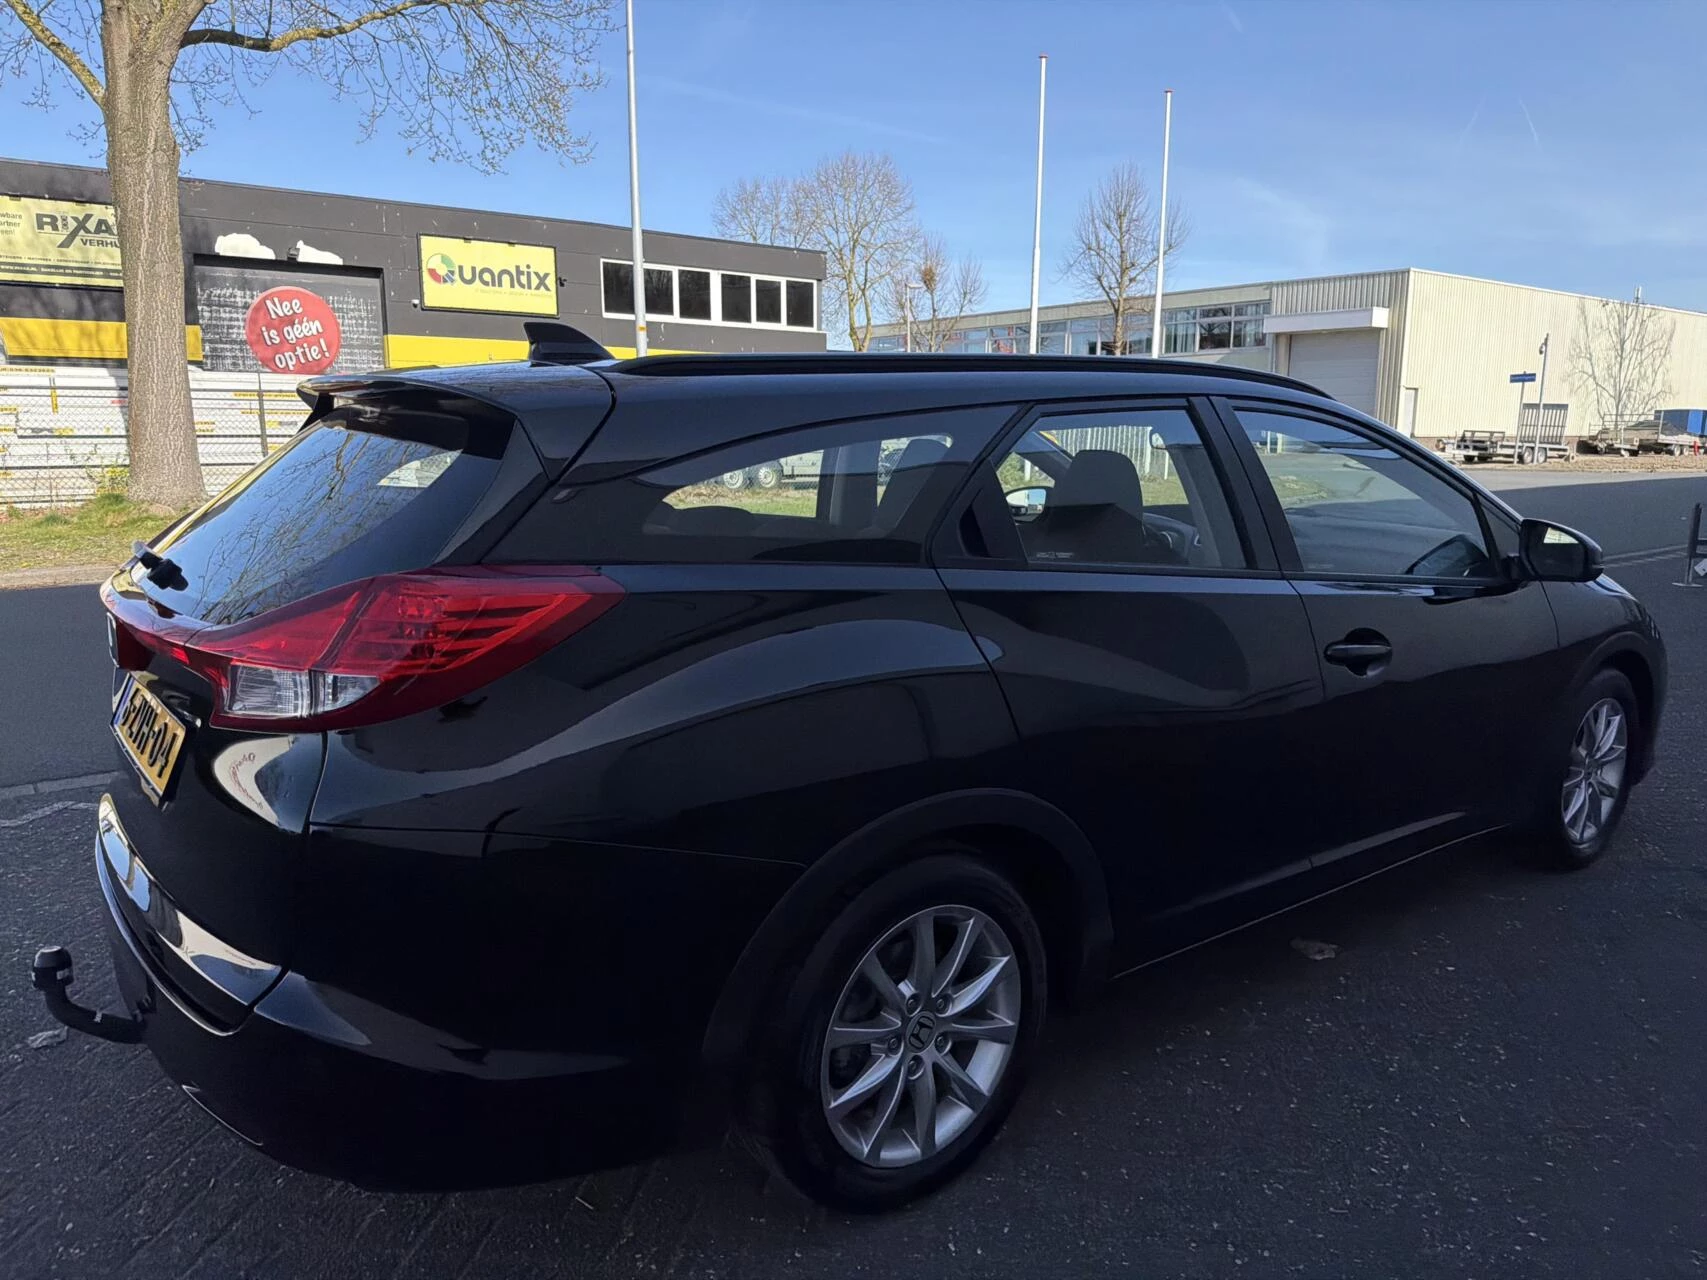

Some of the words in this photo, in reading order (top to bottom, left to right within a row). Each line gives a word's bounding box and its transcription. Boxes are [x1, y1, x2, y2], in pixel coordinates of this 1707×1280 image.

[80, 238, 120, 248] VERHU
[265, 297, 303, 319] Nee
[261, 326, 281, 346] is
[284, 316, 323, 344] géén
[274, 338, 330, 371] optie!
